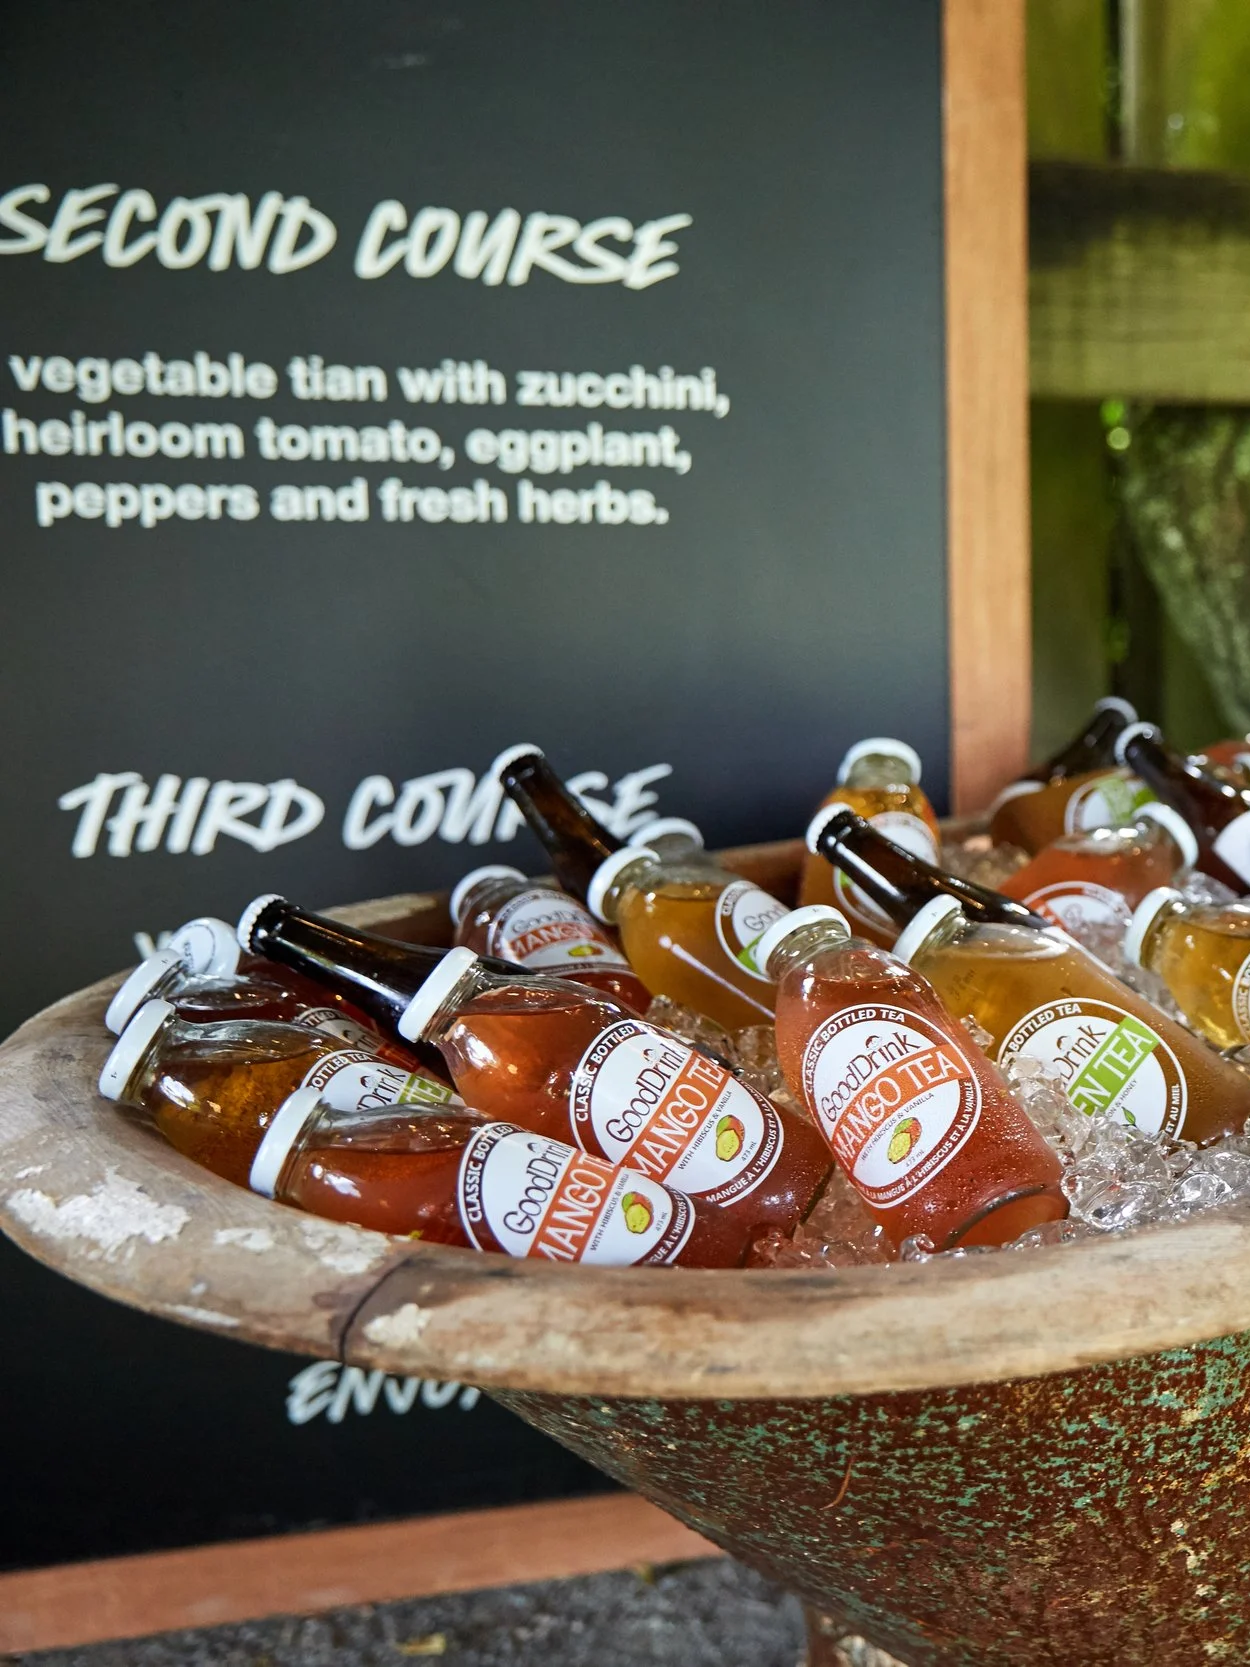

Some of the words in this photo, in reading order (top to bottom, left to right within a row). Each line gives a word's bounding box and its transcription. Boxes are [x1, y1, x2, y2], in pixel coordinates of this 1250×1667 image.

[0, 184, 337, 274] SECOND
[354, 199, 693, 289] COURSE
[9, 352, 277, 402] vegetable
[287, 355, 387, 401] tian
[398, 359, 507, 403] with
[516, 366, 730, 418] zucchini,
[2, 411, 244, 457] heirloom
[258, 418, 455, 470] tomato,
[464, 423, 692, 474] eggplant,
[36, 482, 260, 527] peppers
[269, 478, 368, 521] and
[379, 478, 507, 522] fresh
[518, 480, 669, 524] herbs.
[58, 772, 325, 859] THIRD
[350, 1053, 373, 1062] TEA
[806, 1040, 824, 1094] CLASSIC
[821, 1008, 876, 1041] BOTTLED
[880, 1009, 905, 1023] TEA
[1008, 1010, 1055, 1052] BOTTLED
[1055, 1003, 1082, 1016] TEA
[575, 1063, 598, 1122] CLASSIC
[592, 1024, 635, 1064] BOTTLED
[821, 1031, 921, 1123] GoodDrink
[629, 1083, 708, 1176] MANGO
[678, 1150, 695, 1170] WITH
[692, 1119, 715, 1152] HIBISCUS
[716, 1090, 732, 1112] VANILLA
[834, 1076, 901, 1168] MANGO
[897, 1050, 964, 1090] TEA
[949, 1130, 961, 1142] ET
[962, 1113, 972, 1124] LA
[1165, 1119, 1174, 1133] ET
[1170, 1105, 1179, 1119] AU
[465, 1161, 483, 1222] CLASSIC
[705, 1179, 747, 1202] MANGUE
[753, 1129, 777, 1173] L'HIBISCUS
[590, 1230, 604, 1251] WITH
[602, 1198, 618, 1229] HIBISCUS
